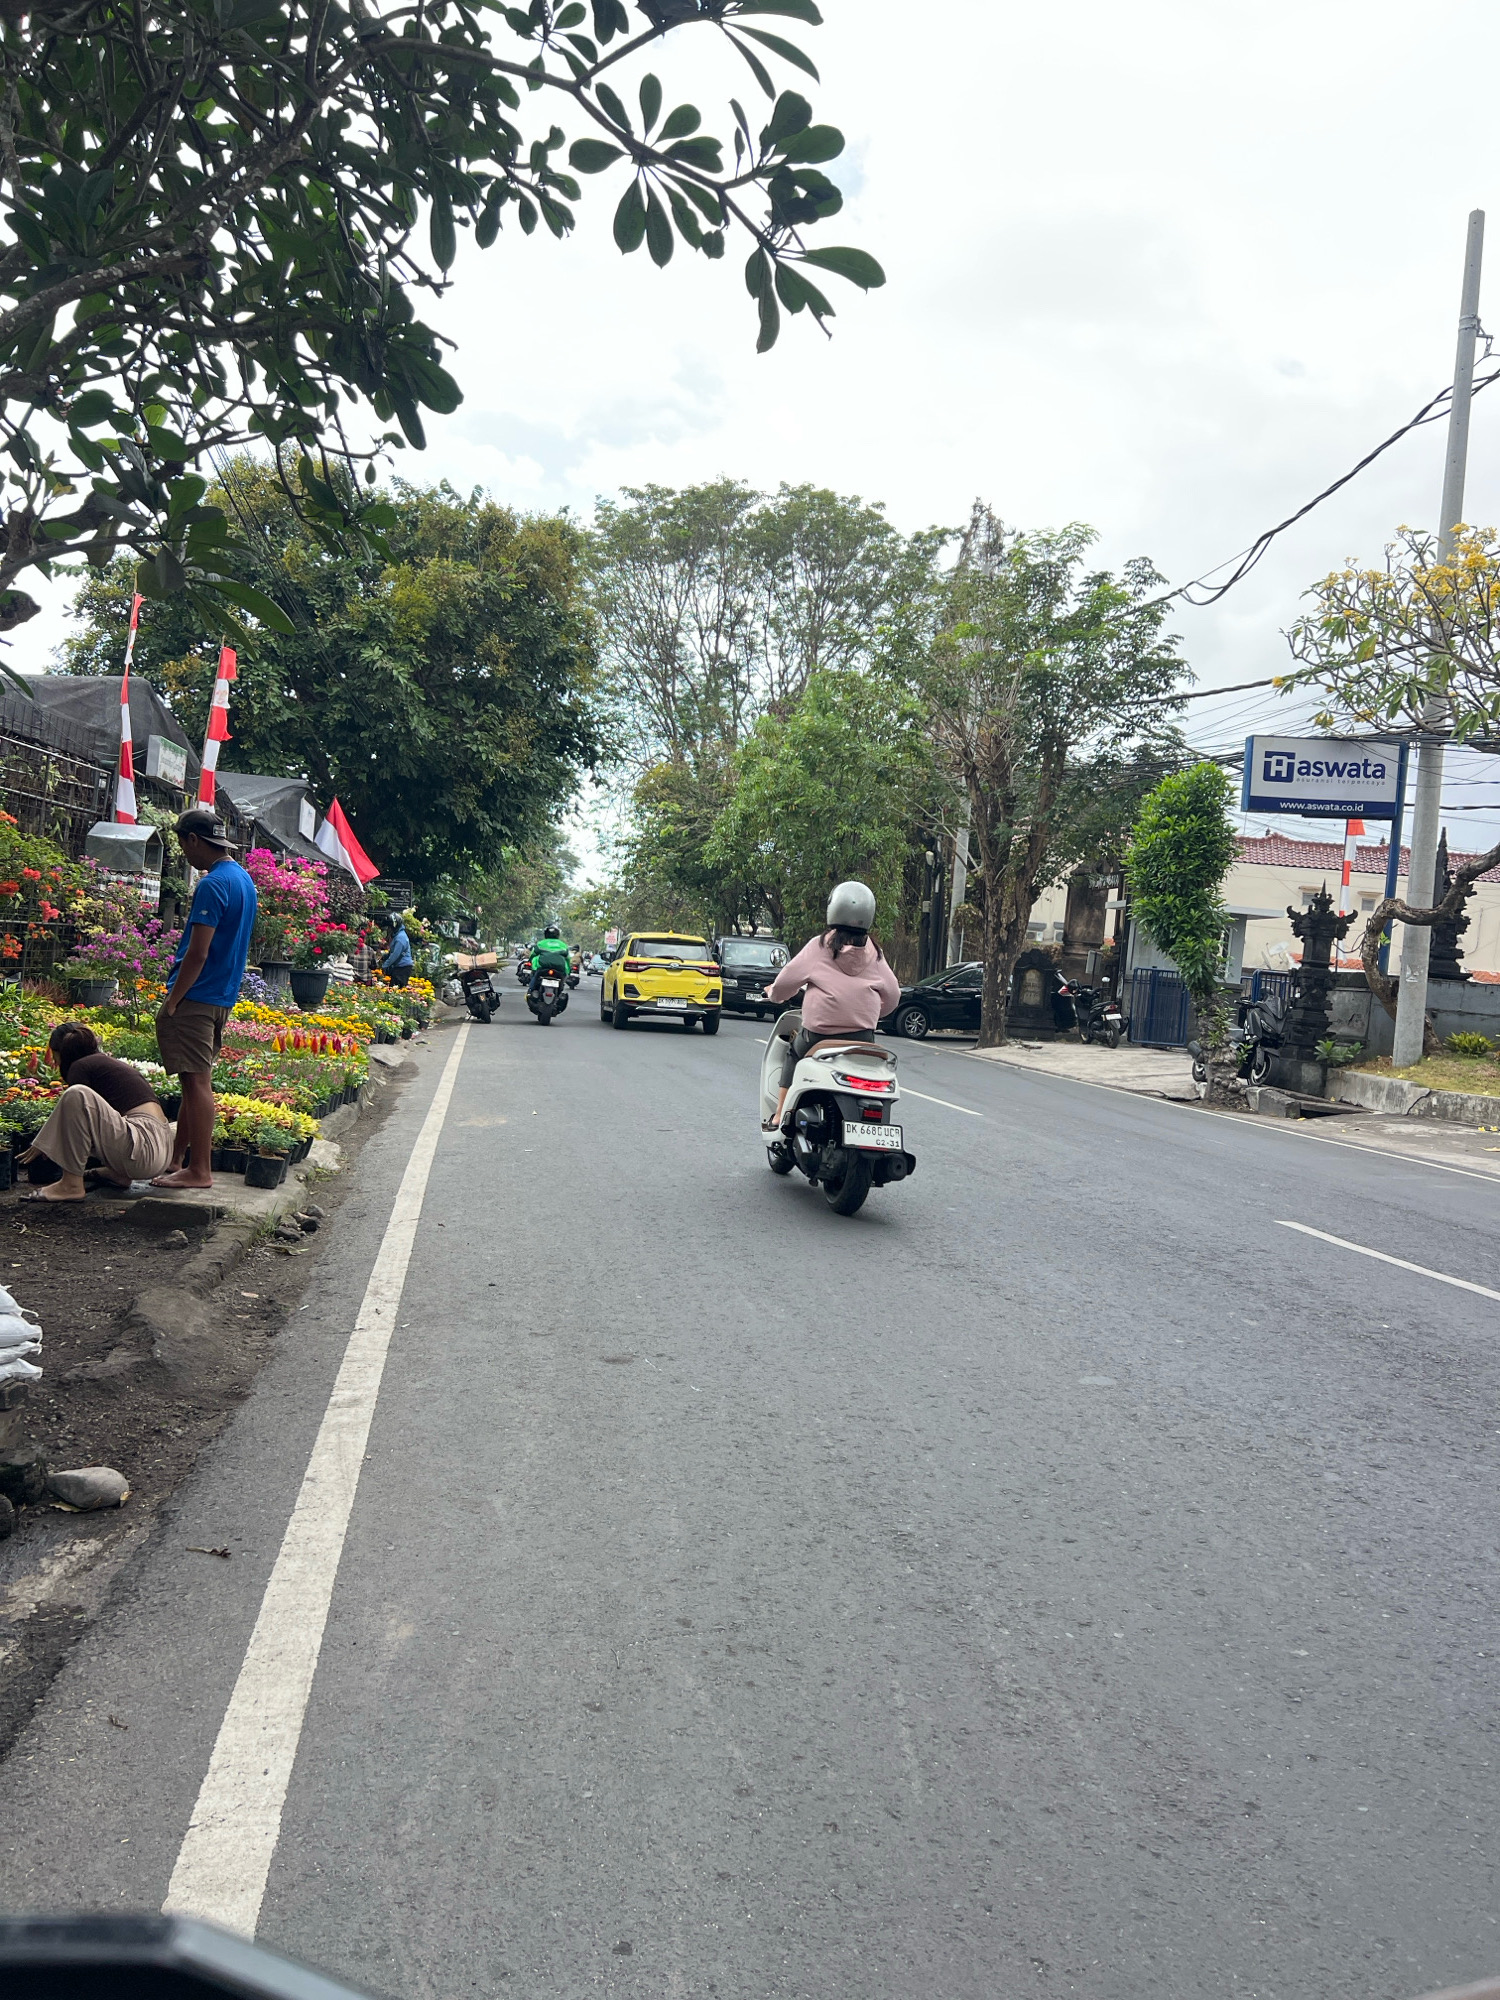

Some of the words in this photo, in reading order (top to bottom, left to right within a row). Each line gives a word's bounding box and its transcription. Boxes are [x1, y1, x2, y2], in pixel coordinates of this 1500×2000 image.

[1297, 758, 1386, 780] aswata
[1280, 800, 1364, 812] www.aswata.co.id
[846, 1124, 857, 1133] DK
